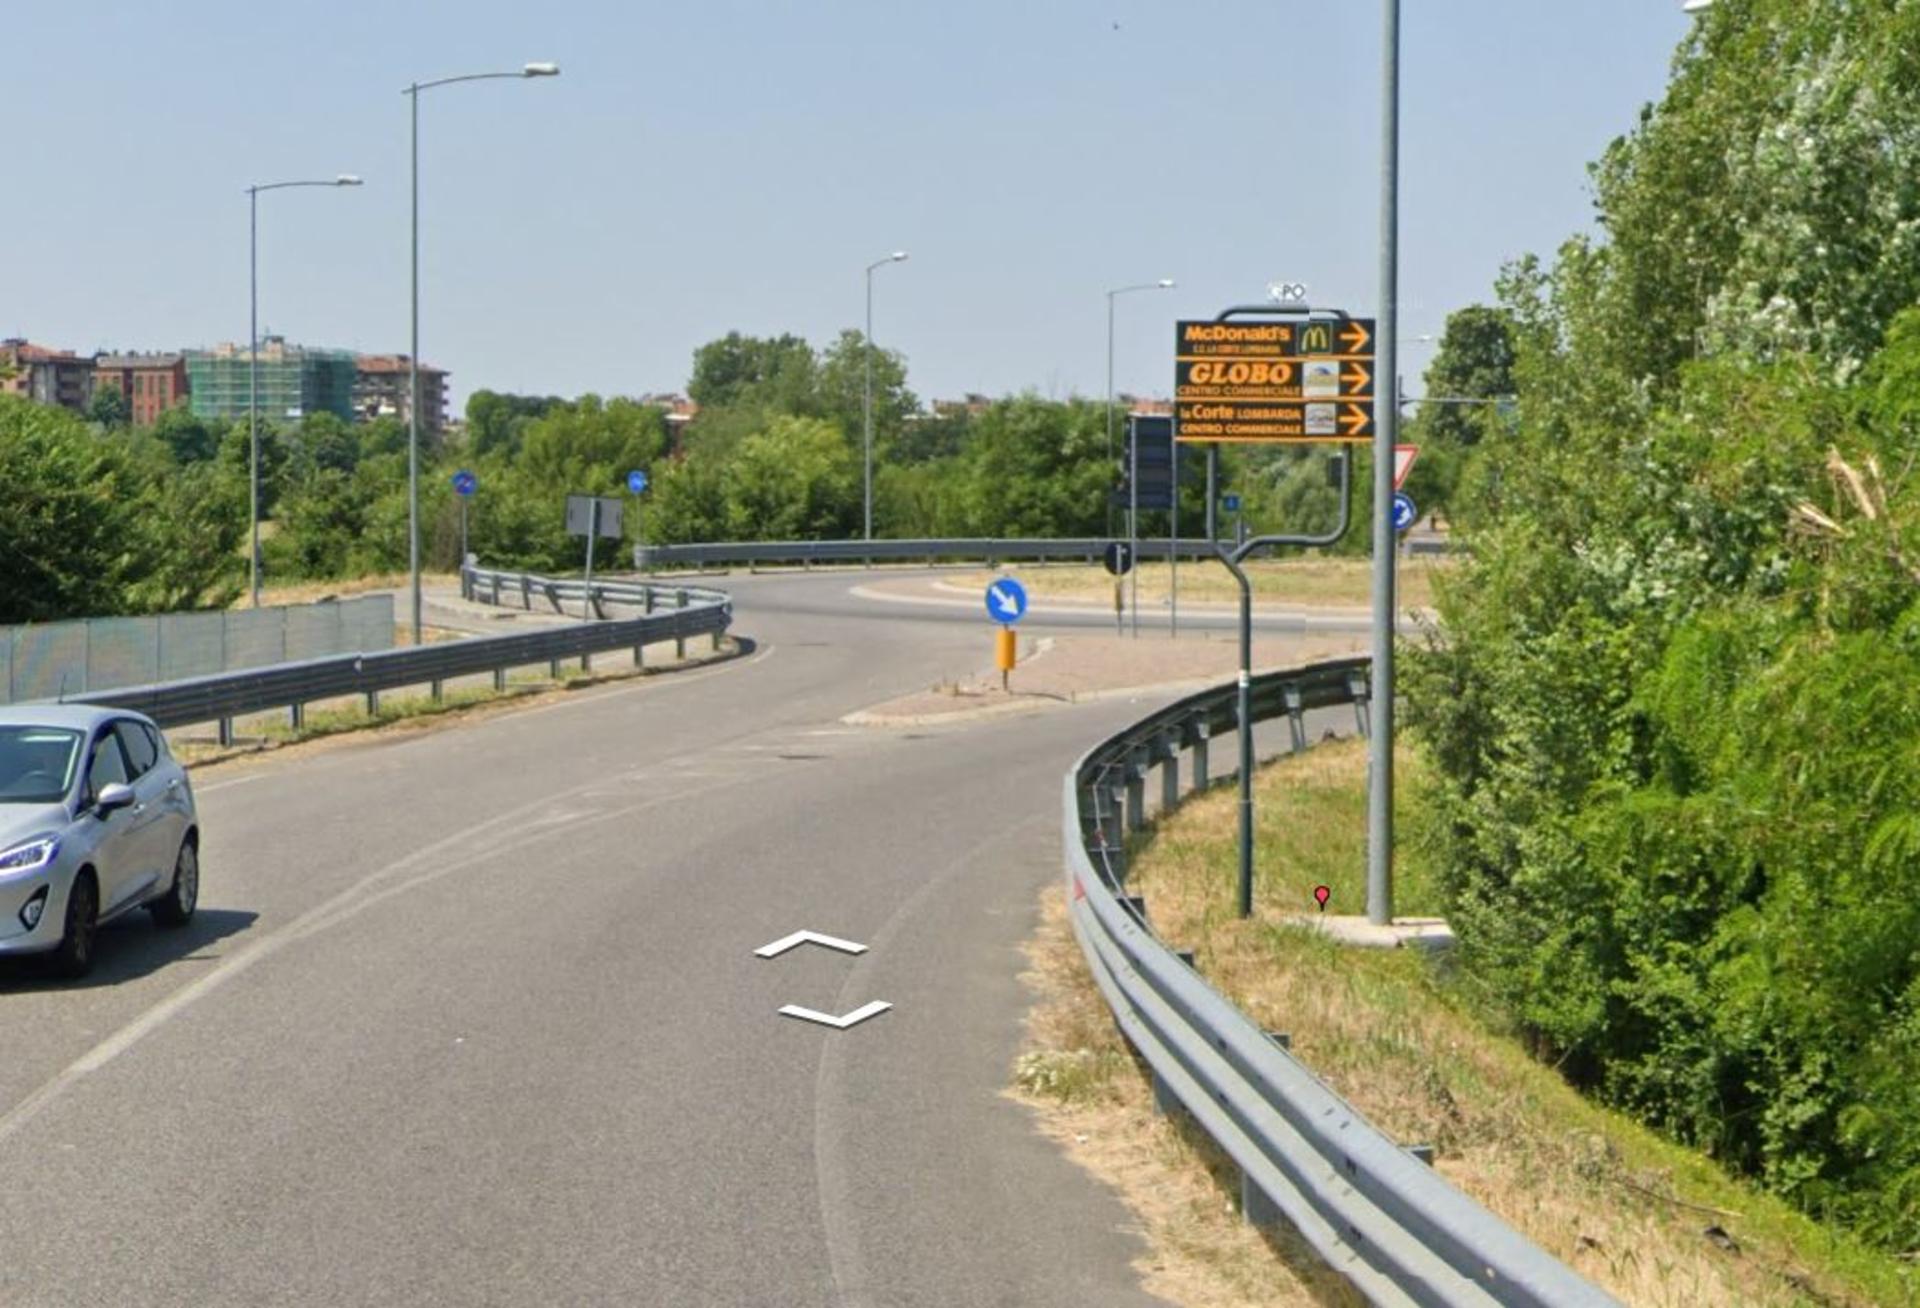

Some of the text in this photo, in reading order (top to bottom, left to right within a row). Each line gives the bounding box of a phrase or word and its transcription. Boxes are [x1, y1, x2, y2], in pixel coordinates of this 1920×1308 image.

[1184, 325, 1291, 341] McDonald's
[1189, 363, 1292, 384] GLOBO
[1178, 386, 1220, 396] CENTRO
[1192, 404, 1233, 419] Corte
[1180, 424, 1223, 434] CENTRO
